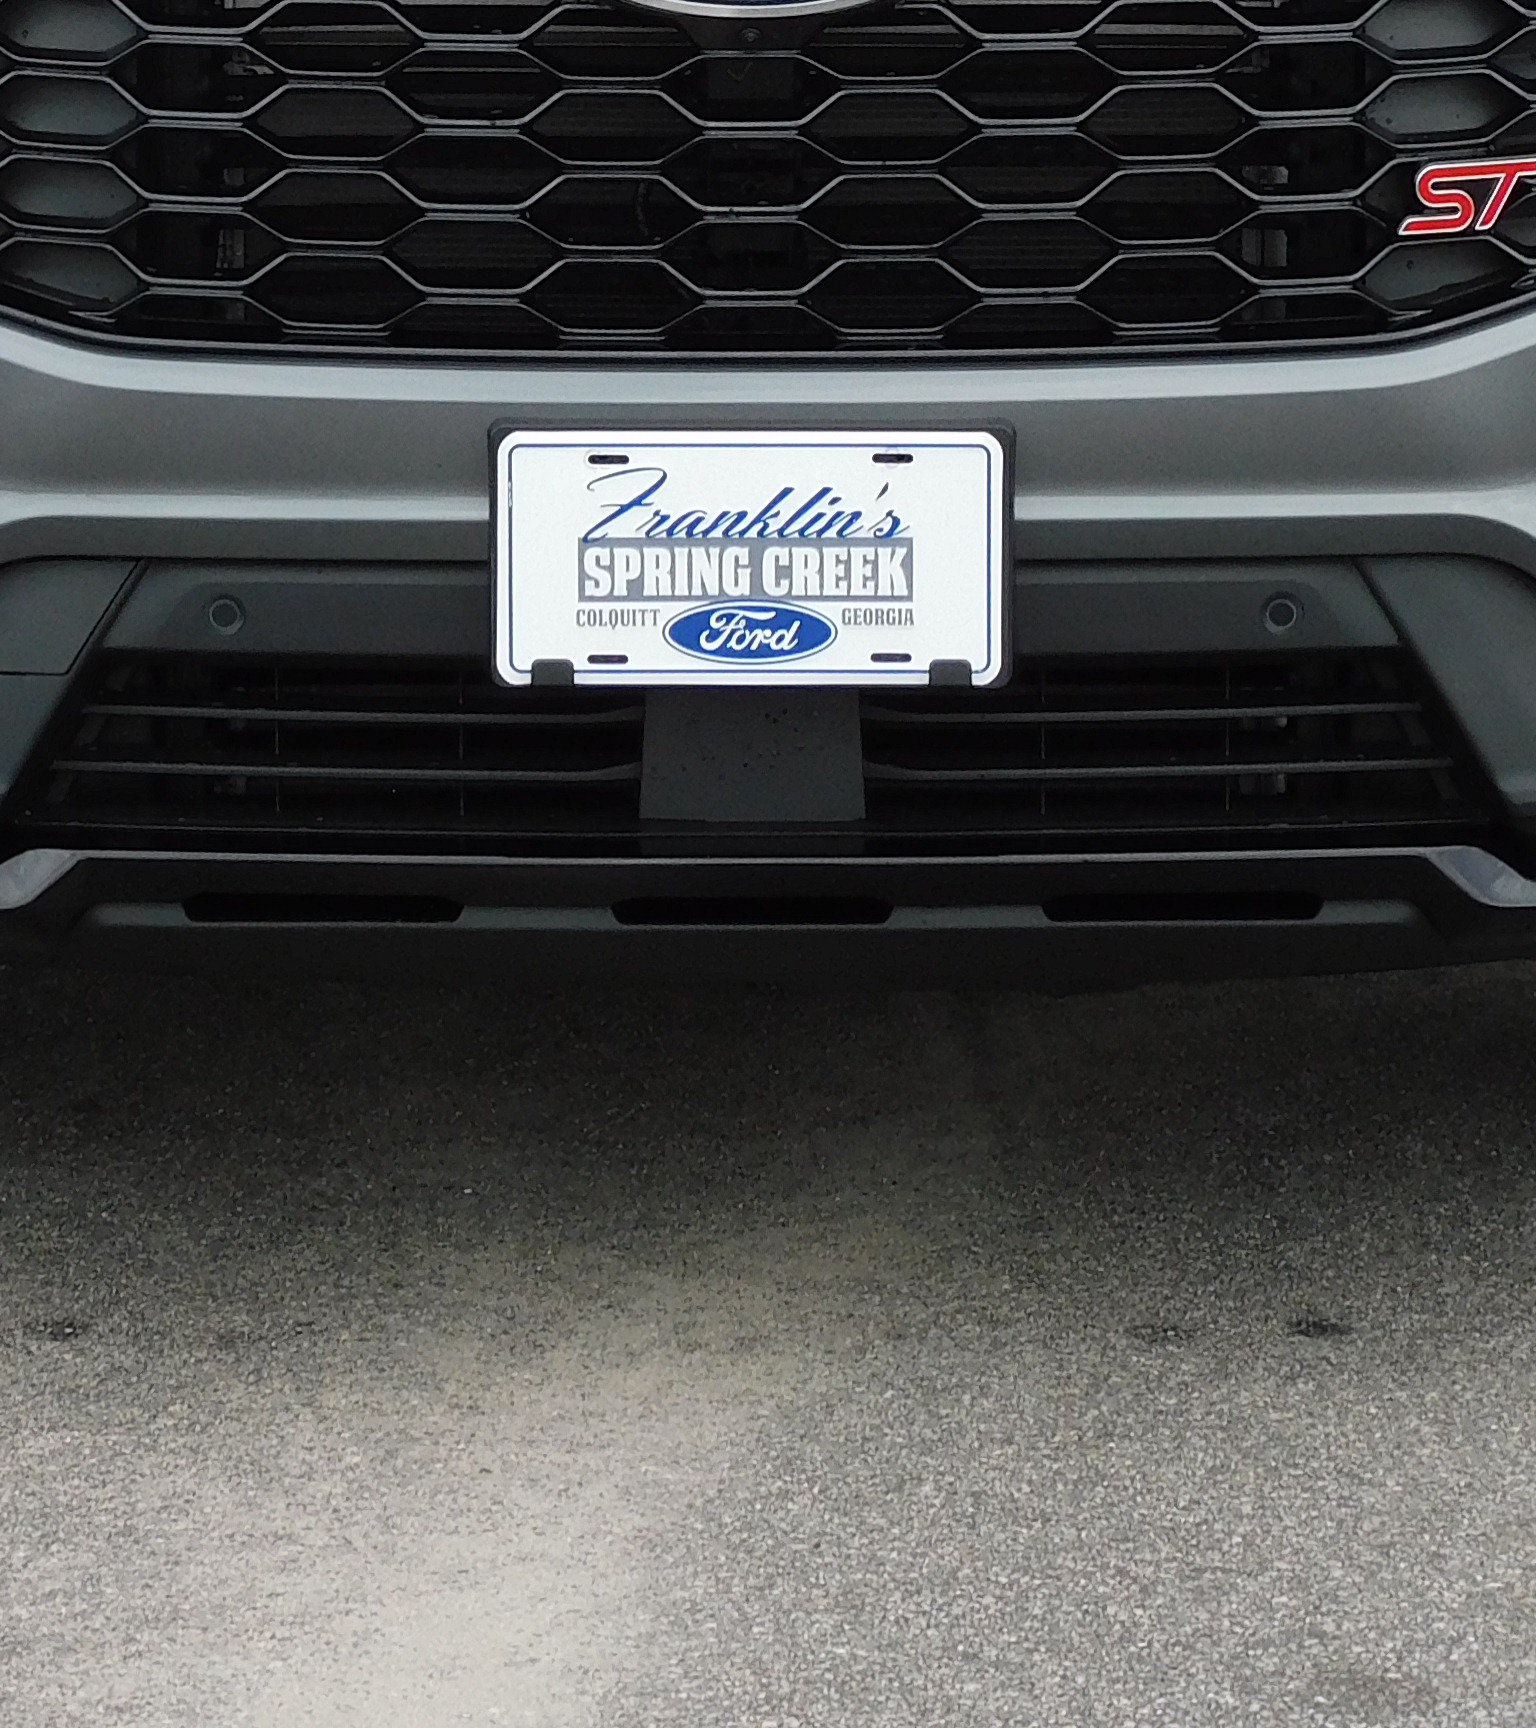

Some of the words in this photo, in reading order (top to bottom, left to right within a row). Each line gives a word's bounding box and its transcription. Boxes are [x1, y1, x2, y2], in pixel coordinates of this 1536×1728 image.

[581, 467, 911, 544] Franklin's
[583, 546, 753, 597] SPRING
[762, 546, 909, 597] CREEK
[575, 608, 662, 631] COLQUITT
[698, 608, 802, 653] Ford
[841, 607, 916, 627] GEORGIA
